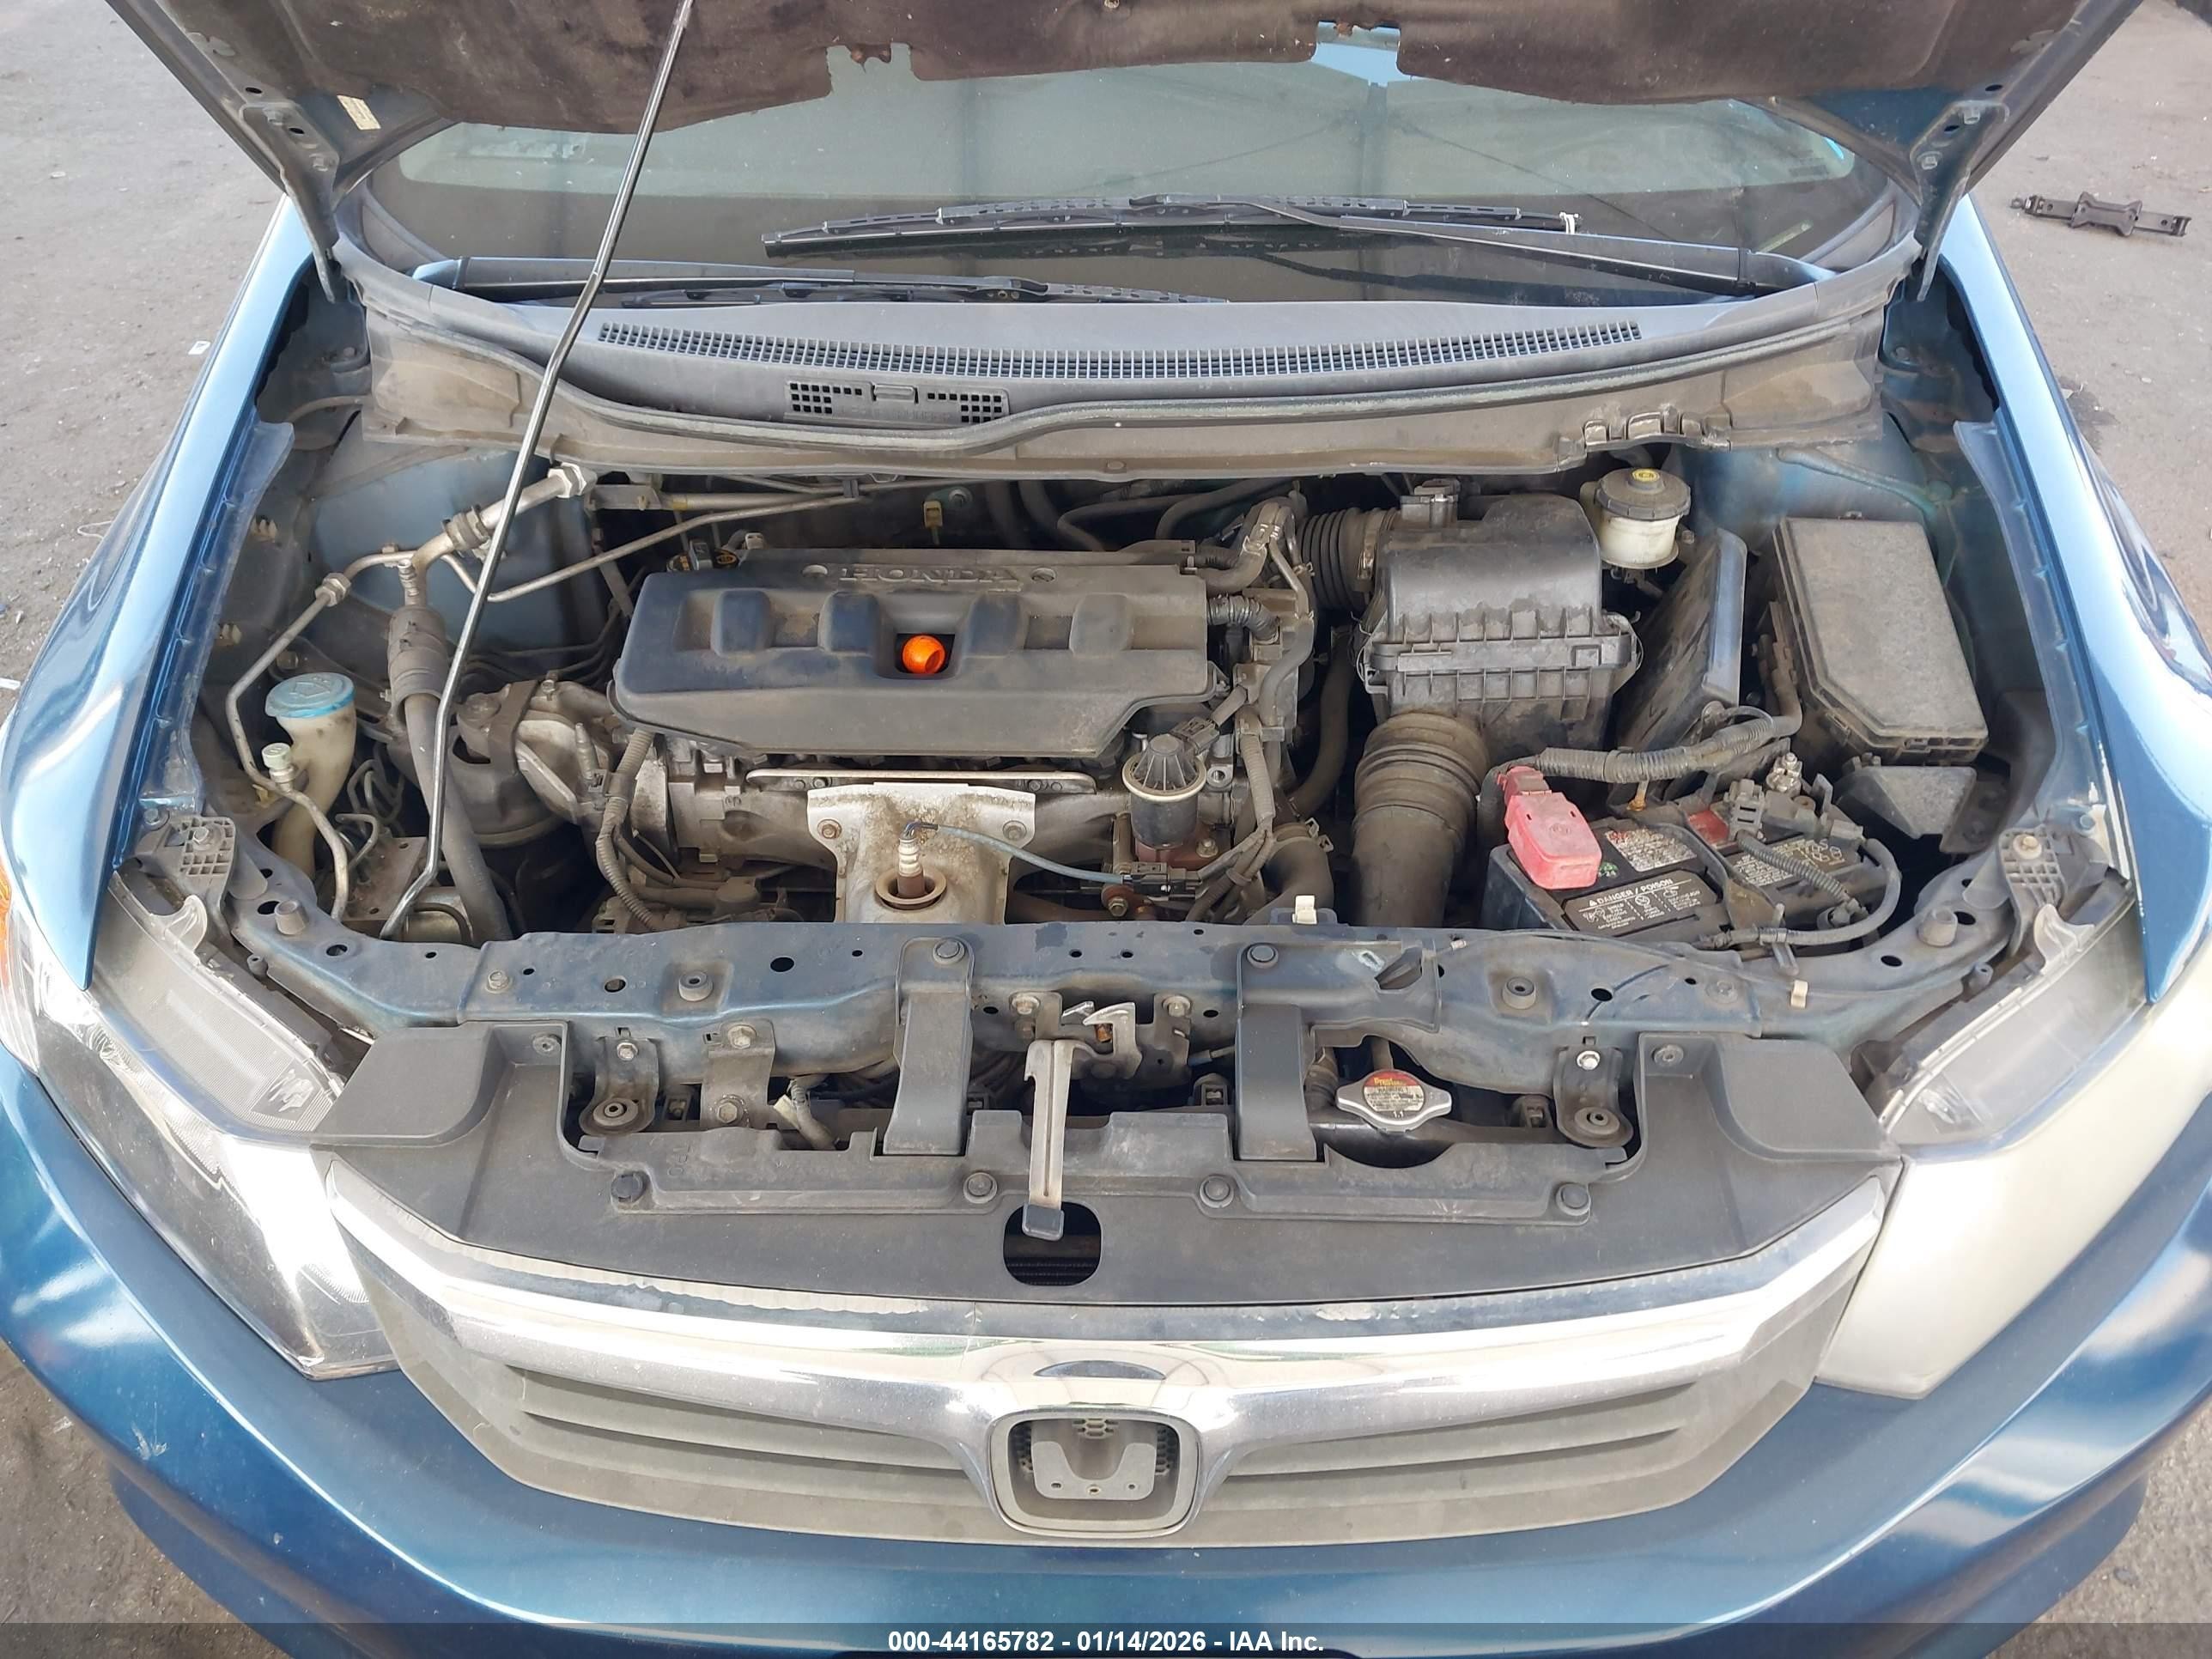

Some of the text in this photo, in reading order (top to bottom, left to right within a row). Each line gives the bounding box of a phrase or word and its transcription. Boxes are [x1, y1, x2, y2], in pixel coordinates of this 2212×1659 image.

[839, 566, 1018, 583] HONDA
[1597, 890, 1634, 905] DANGER
[1640, 878, 1674, 893] POISON
